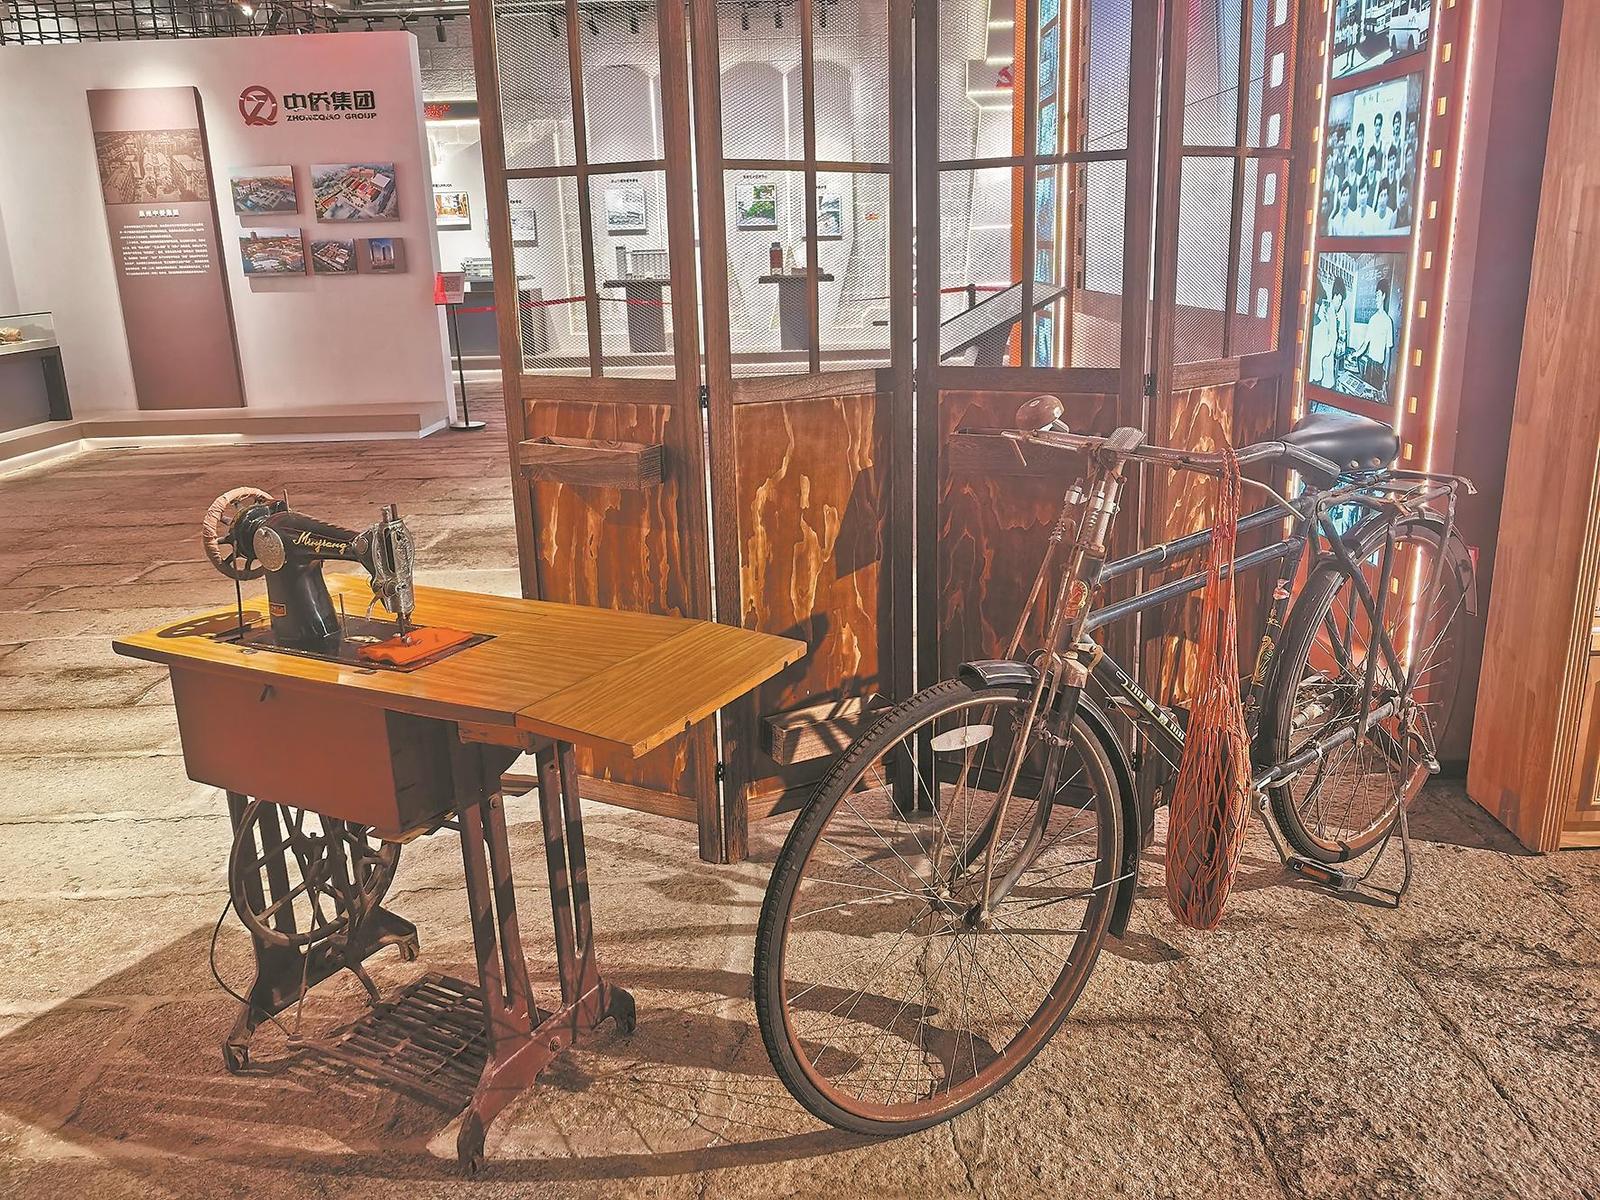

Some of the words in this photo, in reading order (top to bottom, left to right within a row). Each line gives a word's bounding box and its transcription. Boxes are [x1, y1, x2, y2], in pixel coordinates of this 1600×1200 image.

[283, 90, 376, 111] 中侨集团
[344, 112, 377, 120] GROUP
